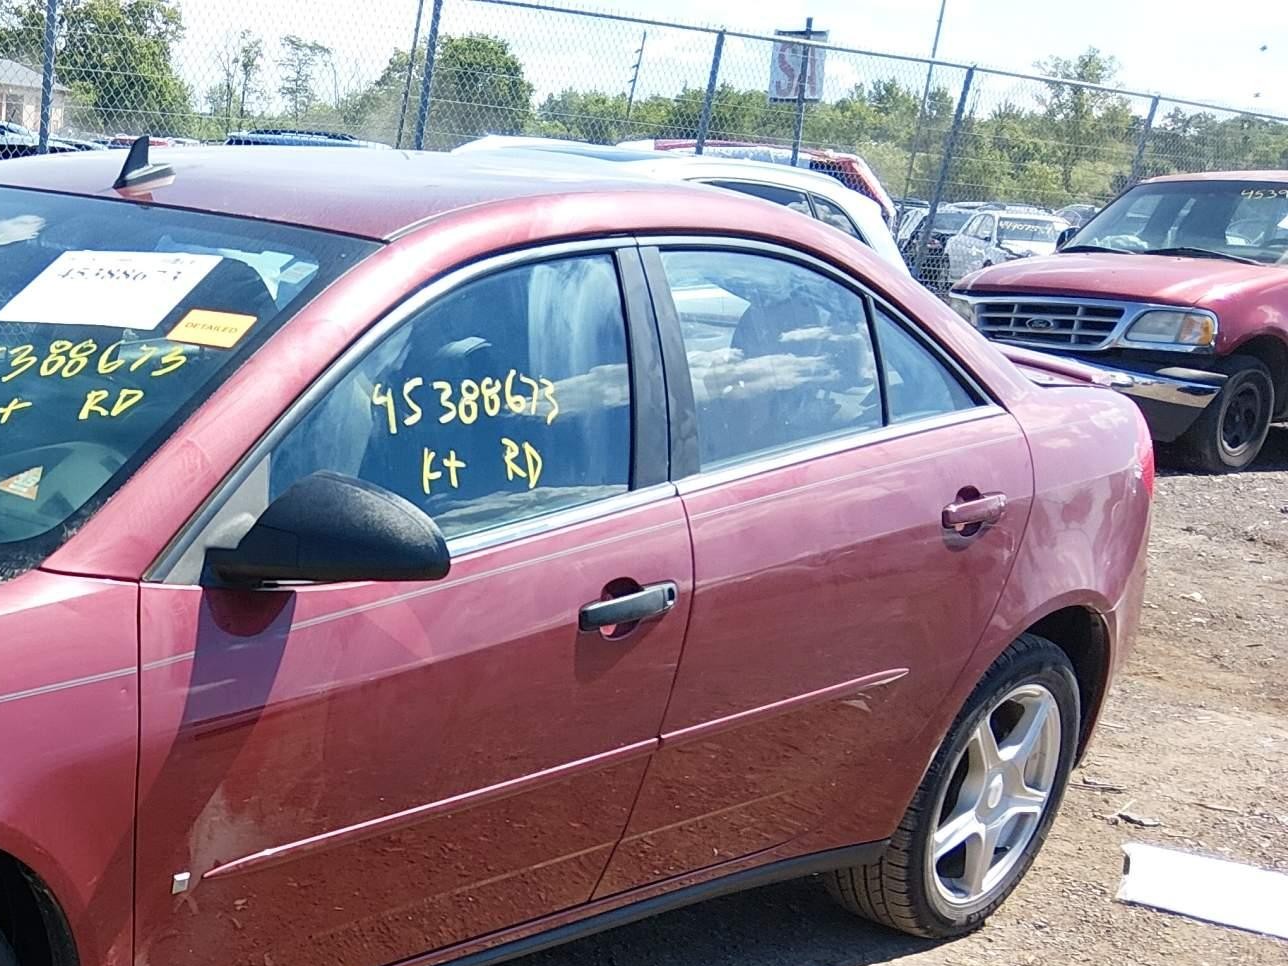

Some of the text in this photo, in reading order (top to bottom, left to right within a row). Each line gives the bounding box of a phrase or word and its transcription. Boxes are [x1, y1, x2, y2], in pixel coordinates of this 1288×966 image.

[184, 321, 239, 334] DETAILED
[78, 388, 144, 420] RD
[372, 368, 559, 434] 45388673
[501, 437, 543, 489] RD
